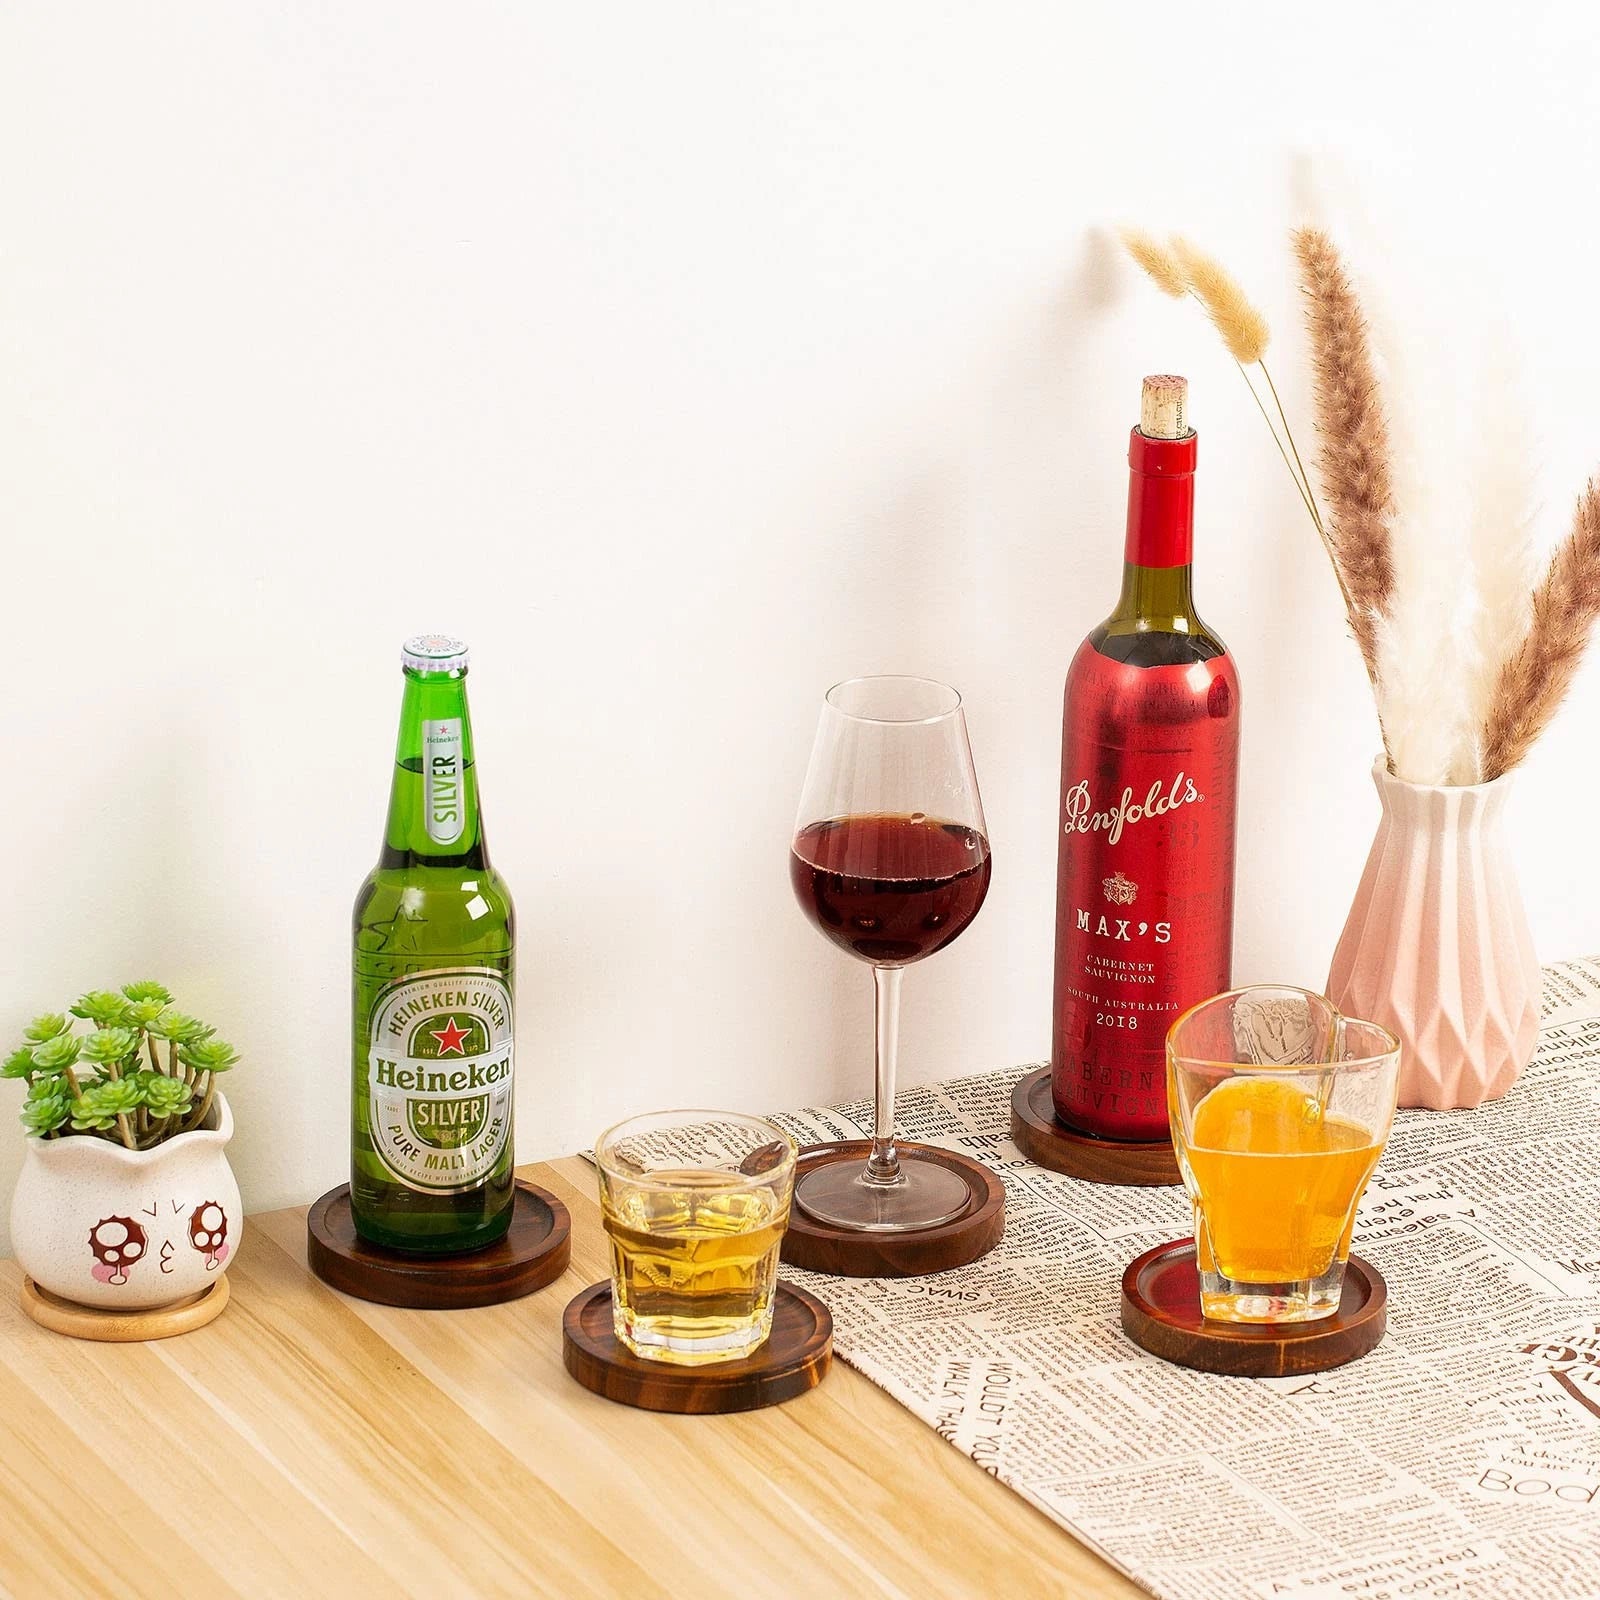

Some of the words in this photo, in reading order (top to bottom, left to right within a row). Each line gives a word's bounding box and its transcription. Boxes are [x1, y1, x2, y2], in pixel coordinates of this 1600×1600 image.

[427, 736, 459, 744] Heineken
[433, 754, 457, 822] SILVER
[1076, 908, 1172, 943] MAX'S
[1086, 954, 1155, 972] CABERNET
[1084, 966, 1157, 984] SAUVIGNON
[1066, 986, 1099, 1004] SOUTH
[1104, 999, 1179, 1011] AUSTRALIA
[389, 991, 468, 1037] HEINEKEN
[471, 992, 505, 1031] SILVER
[1095, 1012, 1138, 1030] 2018
[375, 1057, 510, 1092] Heineken
[417, 1099, 481, 1126] SILVER
[900, 1114, 957, 1127] mounting
[388, 1124, 421, 1163] PURE
[424, 1153, 465, 1171] MALT
[471, 1117, 503, 1163] LAGER
[1371, 1199, 1403, 1213] he
[1404, 1190, 1453, 1204] that
[1356, 1208, 1415, 1229] even
[1457, 1209, 1476, 1218] A
[1035, 1217, 1068, 1230] moved
[1019, 1238, 1069, 1253] biography
[1038, 1246, 1070, 1256] Power
[907, 1285, 981, 1302] SWAC
[940, 1361, 972, 1400] WALK
[1465, 1385, 1527, 1408] points
[1300, 1553, 1424, 1586] salesman
[1341, 1573, 1405, 1592] even
[1405, 1547, 1478, 1573] loved
